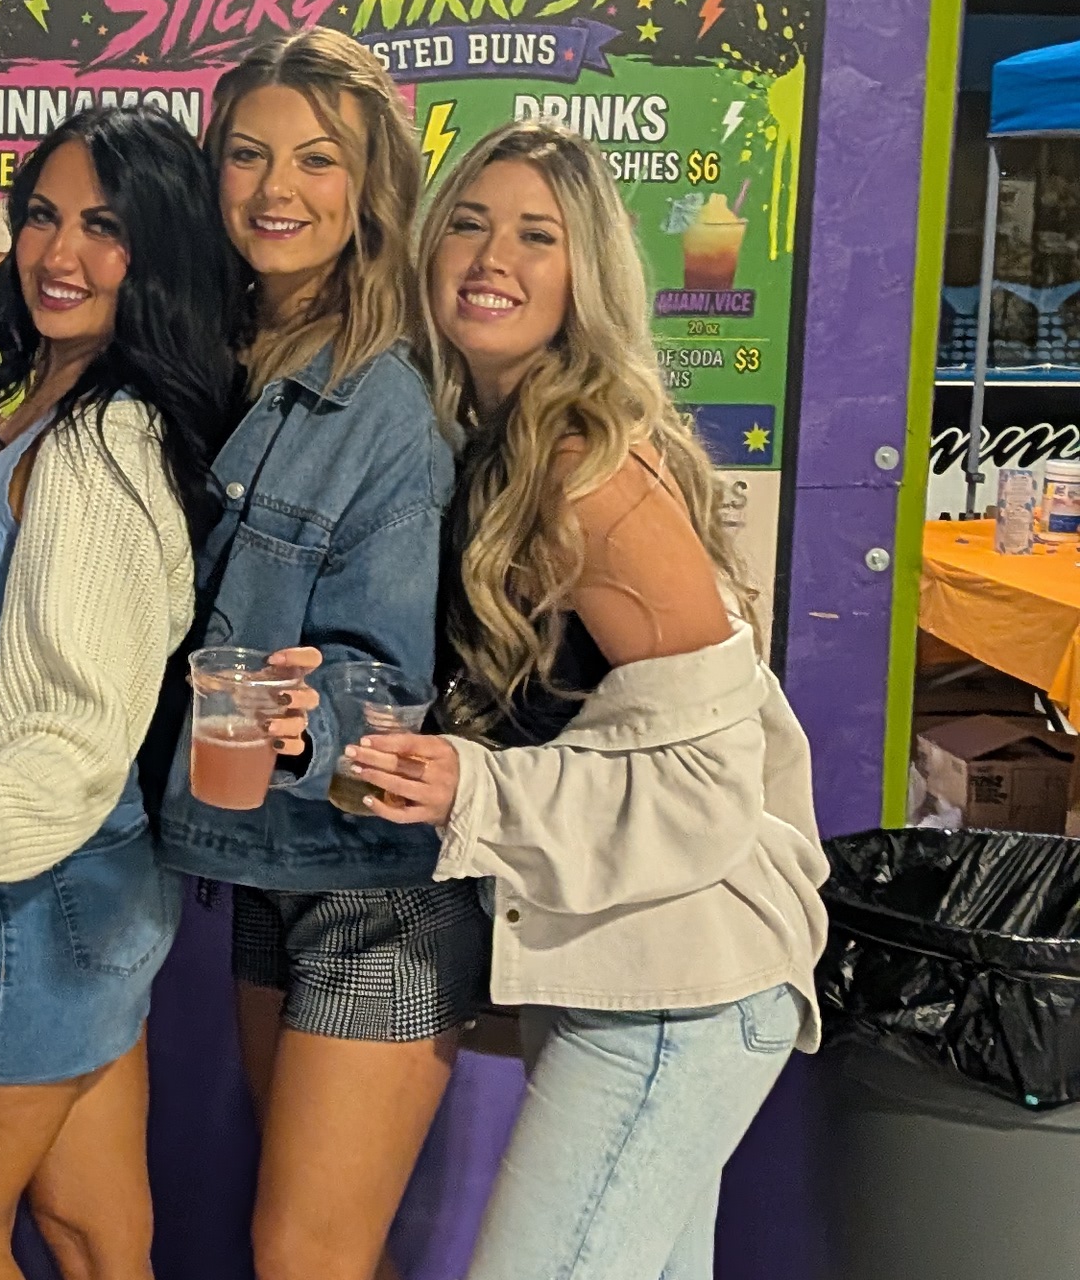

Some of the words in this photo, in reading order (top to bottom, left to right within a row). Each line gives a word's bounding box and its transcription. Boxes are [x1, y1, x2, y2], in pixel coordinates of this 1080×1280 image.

[365, 36, 454, 71] STED
[468, 34, 556, 64] BUNS
[601, 151, 679, 181] SHIES
[688, 150, 719, 184] $6
[658, 292, 710, 313] MIAMI
[716, 292, 751, 312] VICE
[688, 321, 702, 334] 20
[680, 349, 723, 367] SODA
[735, 348, 760, 371] $3
